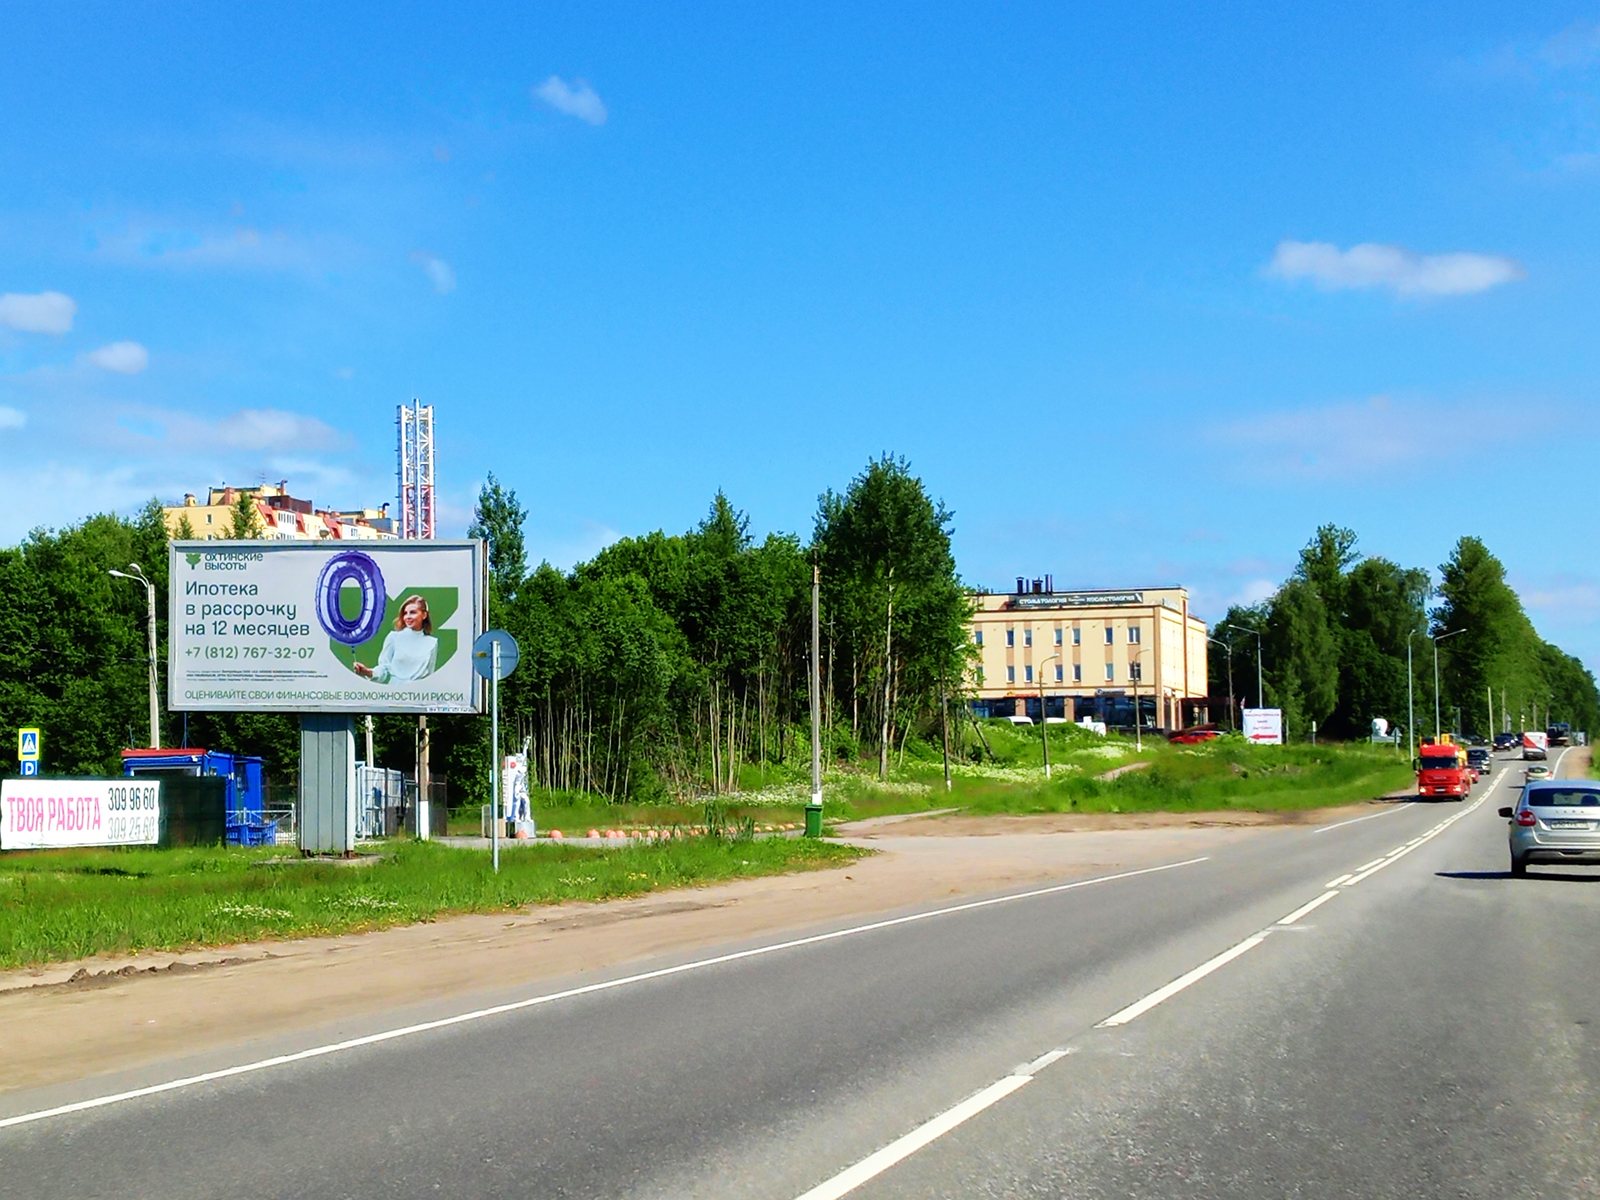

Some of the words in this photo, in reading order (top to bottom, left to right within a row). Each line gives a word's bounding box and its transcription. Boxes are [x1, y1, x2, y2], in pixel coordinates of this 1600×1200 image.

[185, 581, 259, 596] Ипотека
[185, 603, 196, 616] в
[201, 603, 297, 621] рассрочку
[185, 623, 206, 635] на
[211, 620, 228, 636] 12
[233, 623, 310, 639] месяцев
[185, 647, 201, 659] +7
[205, 645, 239, 660] (812)
[243, 647, 315, 659] 767-32-07
[185, 688, 247, 701] ОЦЕНИВАЙТЕ
[247, 690, 275, 700] СВОИ
[275, 690, 342, 701] ФИНАНСОВЫЕ
[343, 691, 420, 701] ВОЗМОЖНОСТИ
[421, 692, 430, 701] И
[430, 692, 464, 701] РИСКИ
[107, 787, 127, 811] 309
[129, 787, 141, 810] 96
[143, 787, 155, 810] 60
[7, 796, 44, 832] ТВОЯ
[47, 796, 101, 831] РАБОТА
[107, 816, 127, 840] 309
